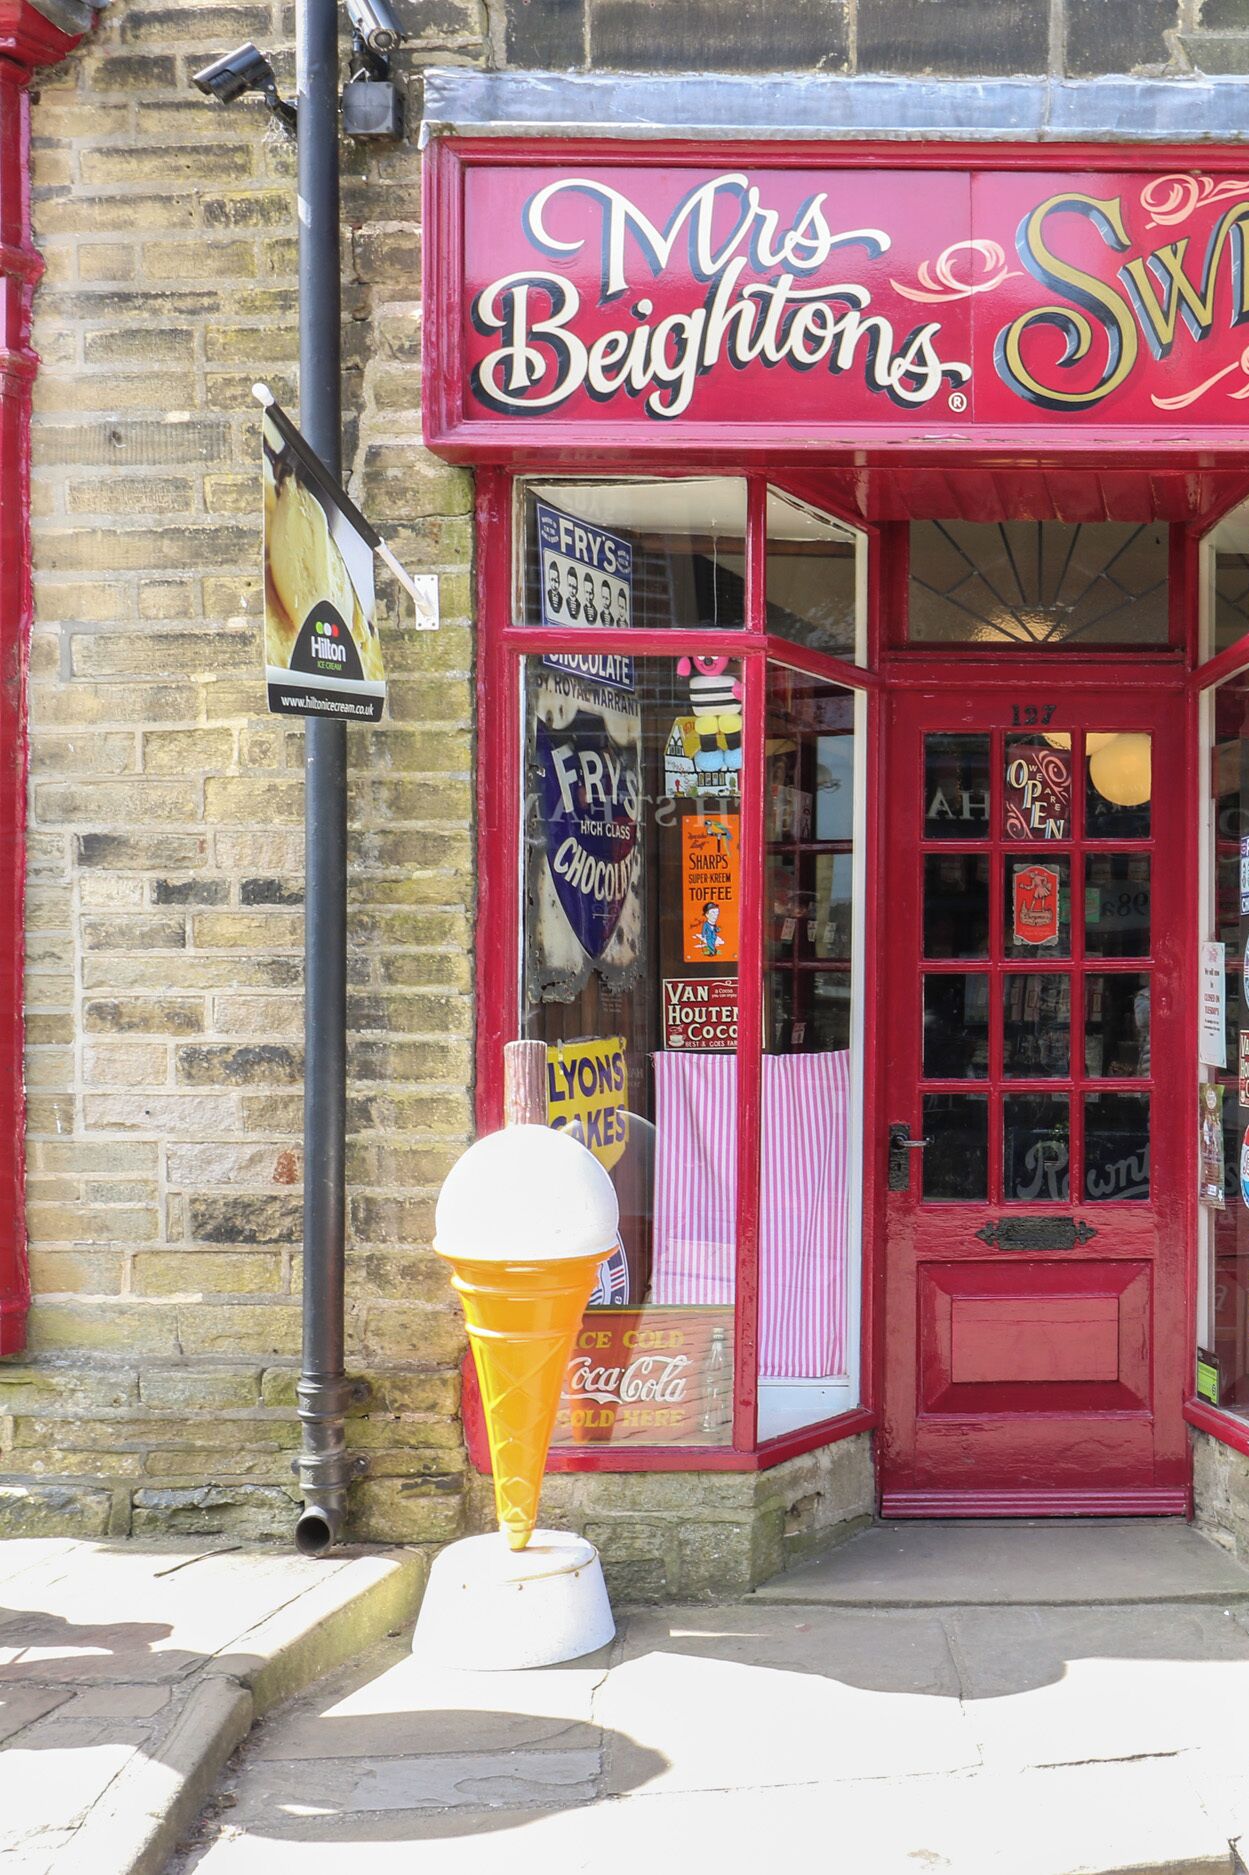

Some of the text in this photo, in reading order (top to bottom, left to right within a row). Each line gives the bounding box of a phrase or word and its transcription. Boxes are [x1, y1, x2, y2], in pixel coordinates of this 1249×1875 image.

[523, 172, 892, 302] Mrs
[471, 256, 972, 420] Beightons
[558, 516, 618, 574] FRY'S
[311, 635, 347, 663] Hilton
[280, 695, 374, 716] www.hiltonicecream.co.uk
[592, 688, 640, 718] WARRANT
[1007, 758, 1066, 840] OPEN
[580, 820, 631, 841] HIGH CLASS
[688, 886, 732, 901] TOFFEE
[666, 983, 710, 1005] VAN
[547, 1052, 625, 1103] LYONS
[622, 1330, 685, 1349] COLD
[622, 1409, 684, 1428] HERE
